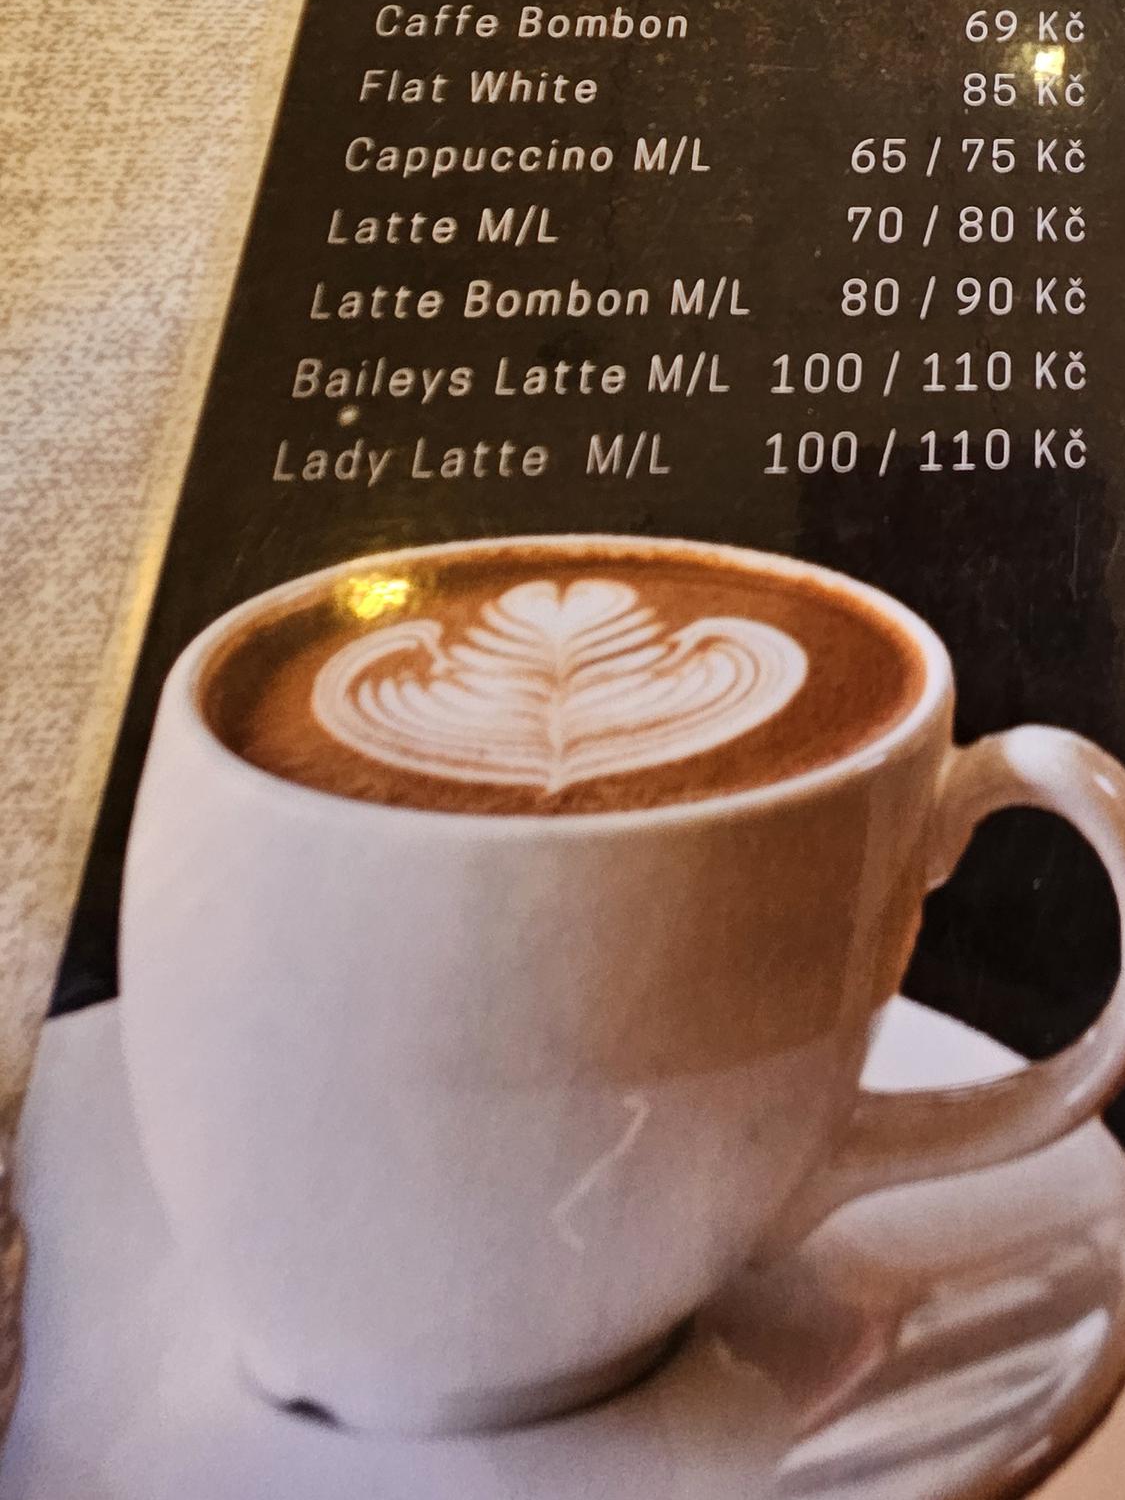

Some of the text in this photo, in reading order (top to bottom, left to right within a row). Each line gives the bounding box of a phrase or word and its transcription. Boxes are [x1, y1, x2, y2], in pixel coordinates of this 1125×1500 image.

[375, 4, 688, 39] Caffe Bombon
[965, 9, 1085, 43] 69 Kč
[359, 69, 598, 104] Flat White
[963, 72, 1086, 108] 85 Kč
[345, 135, 711, 179] Cappuccino M/L
[851, 136, 1086, 177] 65 / 75 Kč
[327, 204, 559, 247] Latte M/L
[847, 204, 1086, 247] 70 / 80 Kč
[310, 276, 750, 320] Latte Bombon M/L
[841, 275, 1086, 320] 80 / 90 Kč
[291, 351, 730, 405] Baileys Latte M/L
[770, 350, 1086, 397] 100 / 110 Kč
[272, 431, 669, 488] Lady Latte M/L
[764, 427, 1087, 477] 100 / 110 Kč
